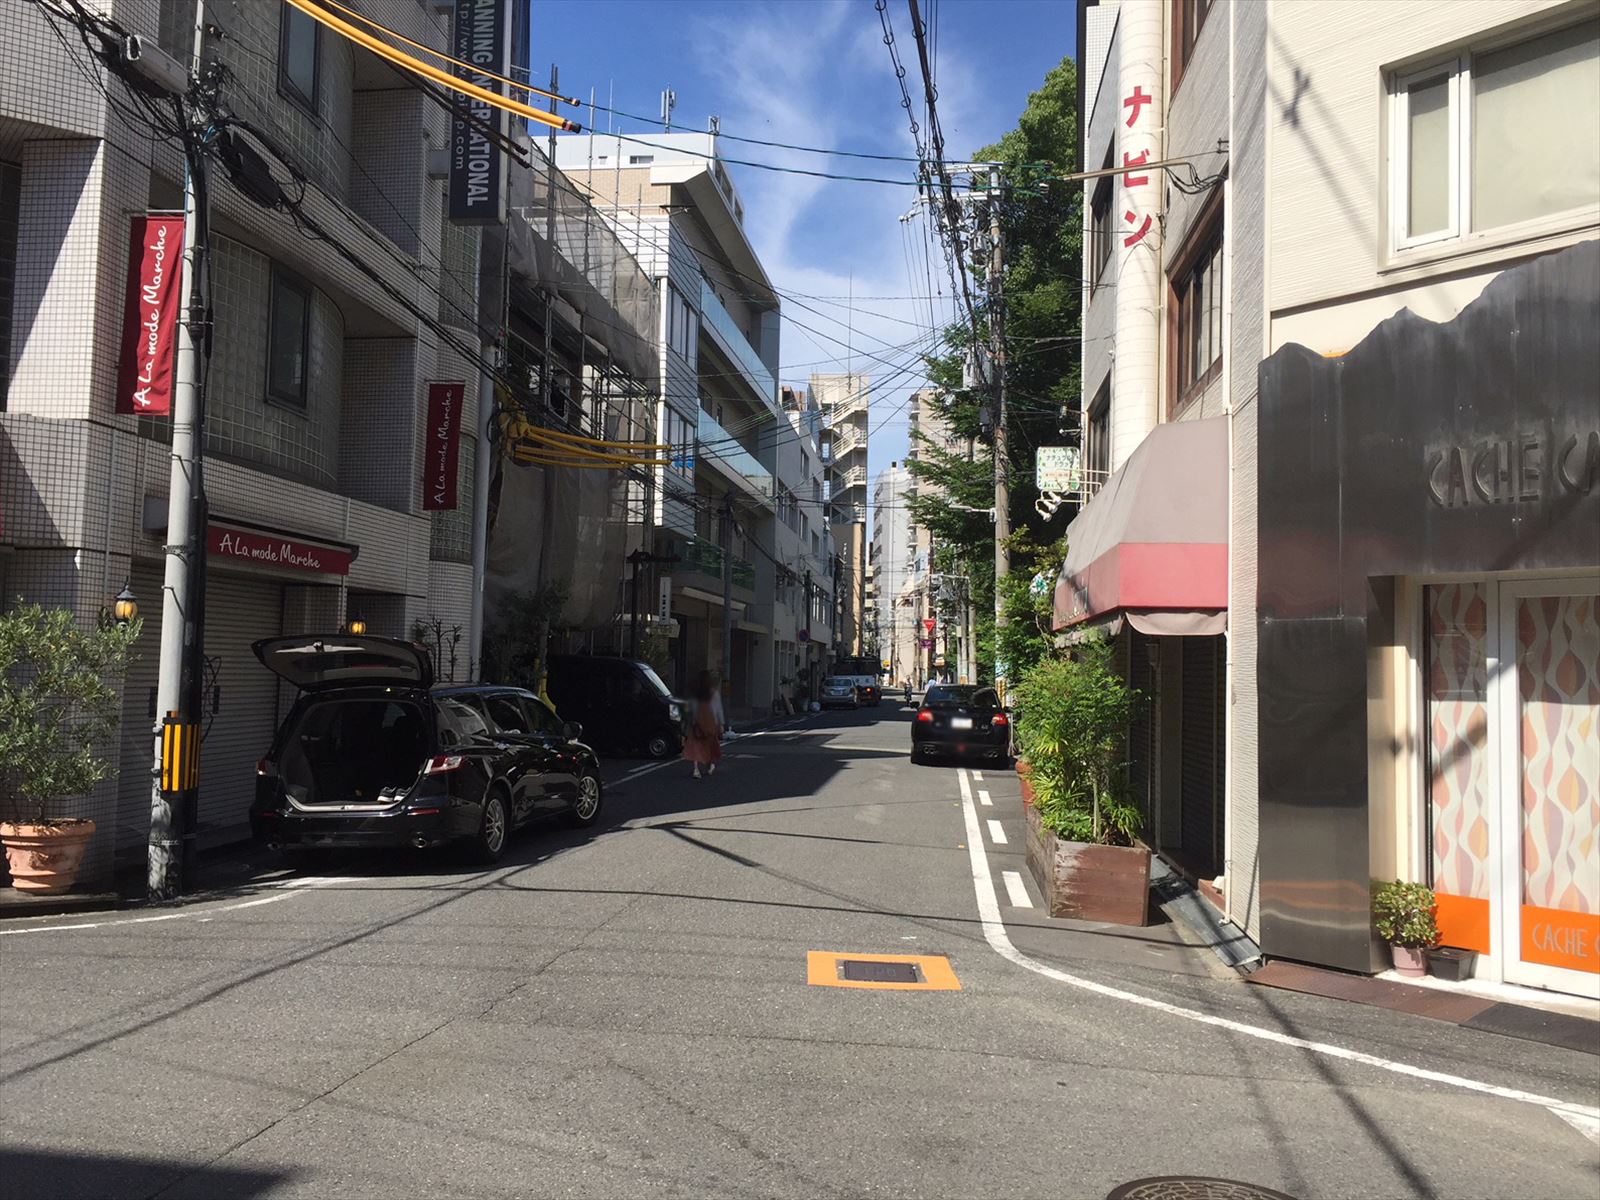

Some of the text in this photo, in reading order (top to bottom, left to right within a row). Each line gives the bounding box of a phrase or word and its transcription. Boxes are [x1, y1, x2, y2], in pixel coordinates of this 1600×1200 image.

[467, 67, 493, 207] NERATIONAL
[1123, 85, 1153, 248] ナビン
[133, 225, 167, 407] A La mode Marche
[434, 389, 453, 504] A La mode Marche
[1428, 436, 1540, 507] CACHE
[219, 533, 320, 568] A La mode Marche
[1532, 923, 1589, 957] CACHE
